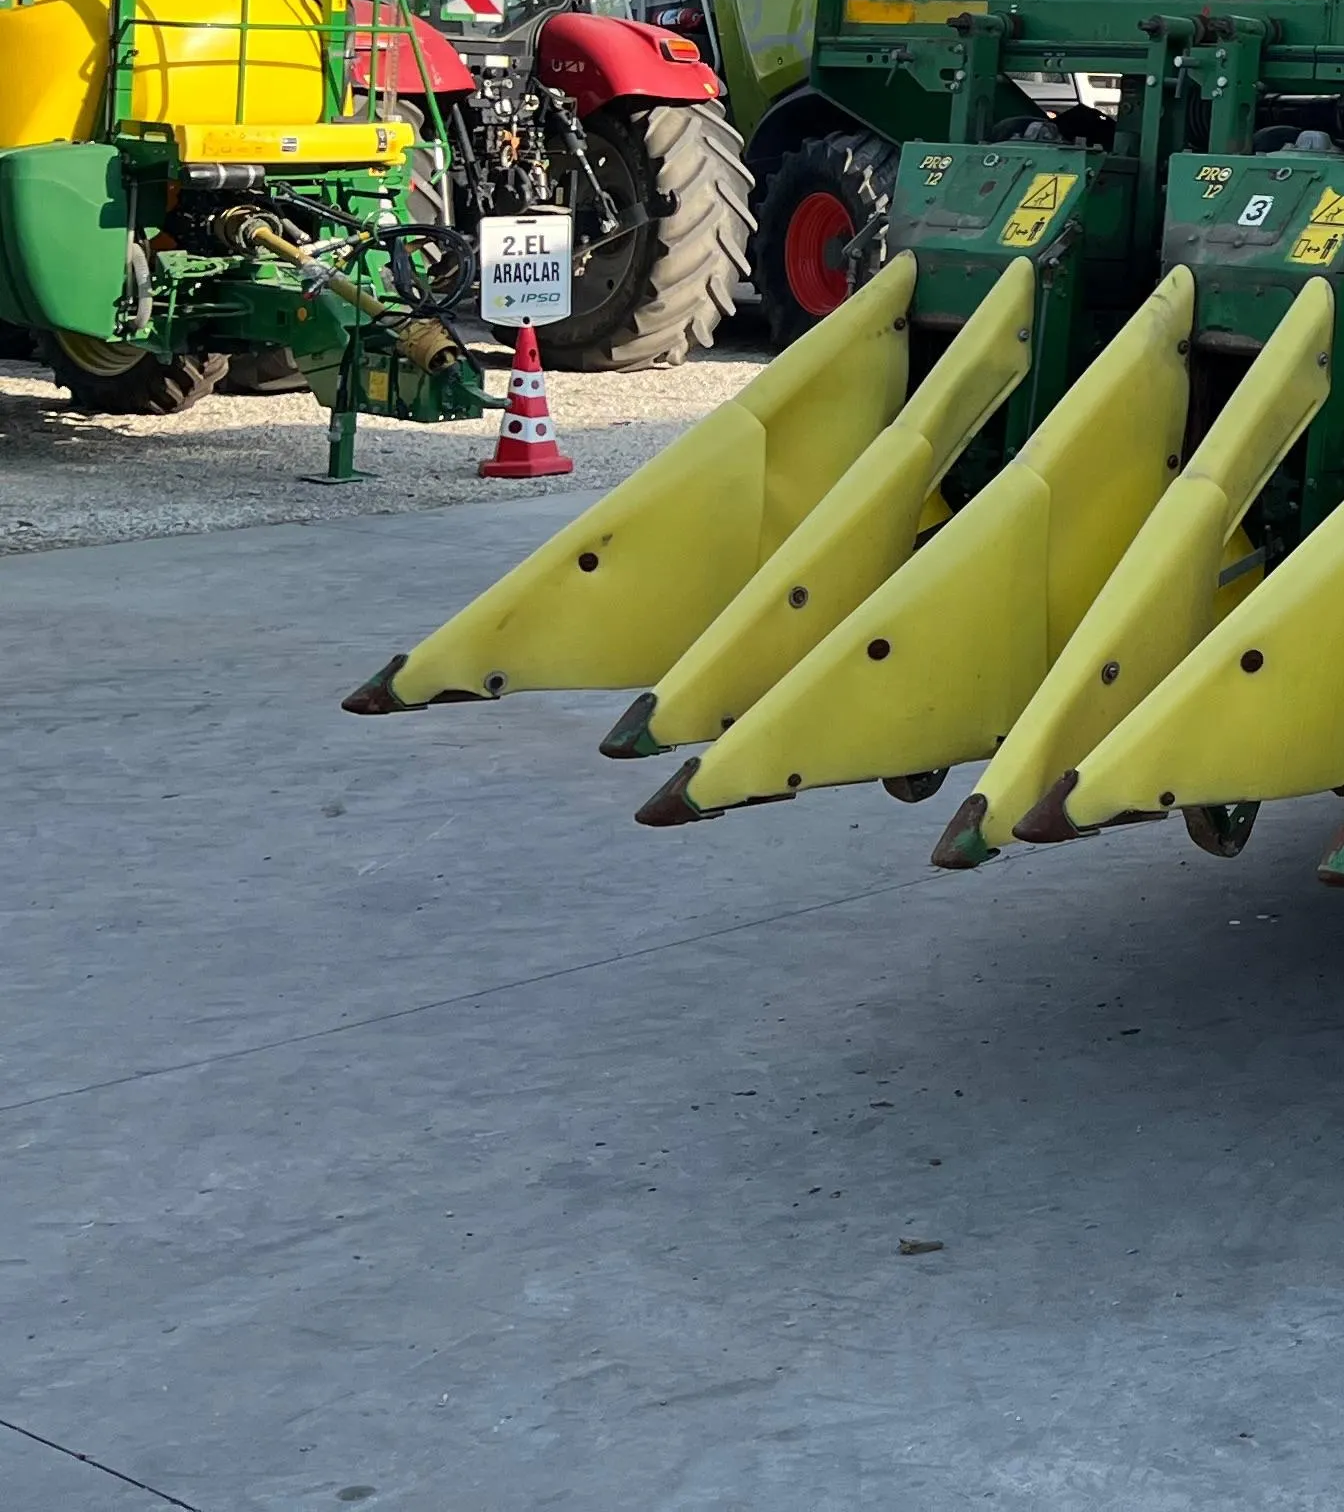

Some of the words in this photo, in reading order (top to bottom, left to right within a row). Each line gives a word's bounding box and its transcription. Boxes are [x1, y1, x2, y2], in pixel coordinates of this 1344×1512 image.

[919, 155, 953, 169] PRO
[924, 171, 943, 186] 12
[1195, 166, 1232, 182] PRO
[1202, 184, 1223, 199] 12
[1245, 199, 1269, 221] 3
[502, 235, 551, 256] 2.EL
[493, 261, 560, 285] ARAÇLAR
[520, 292, 561, 304] IPSO
